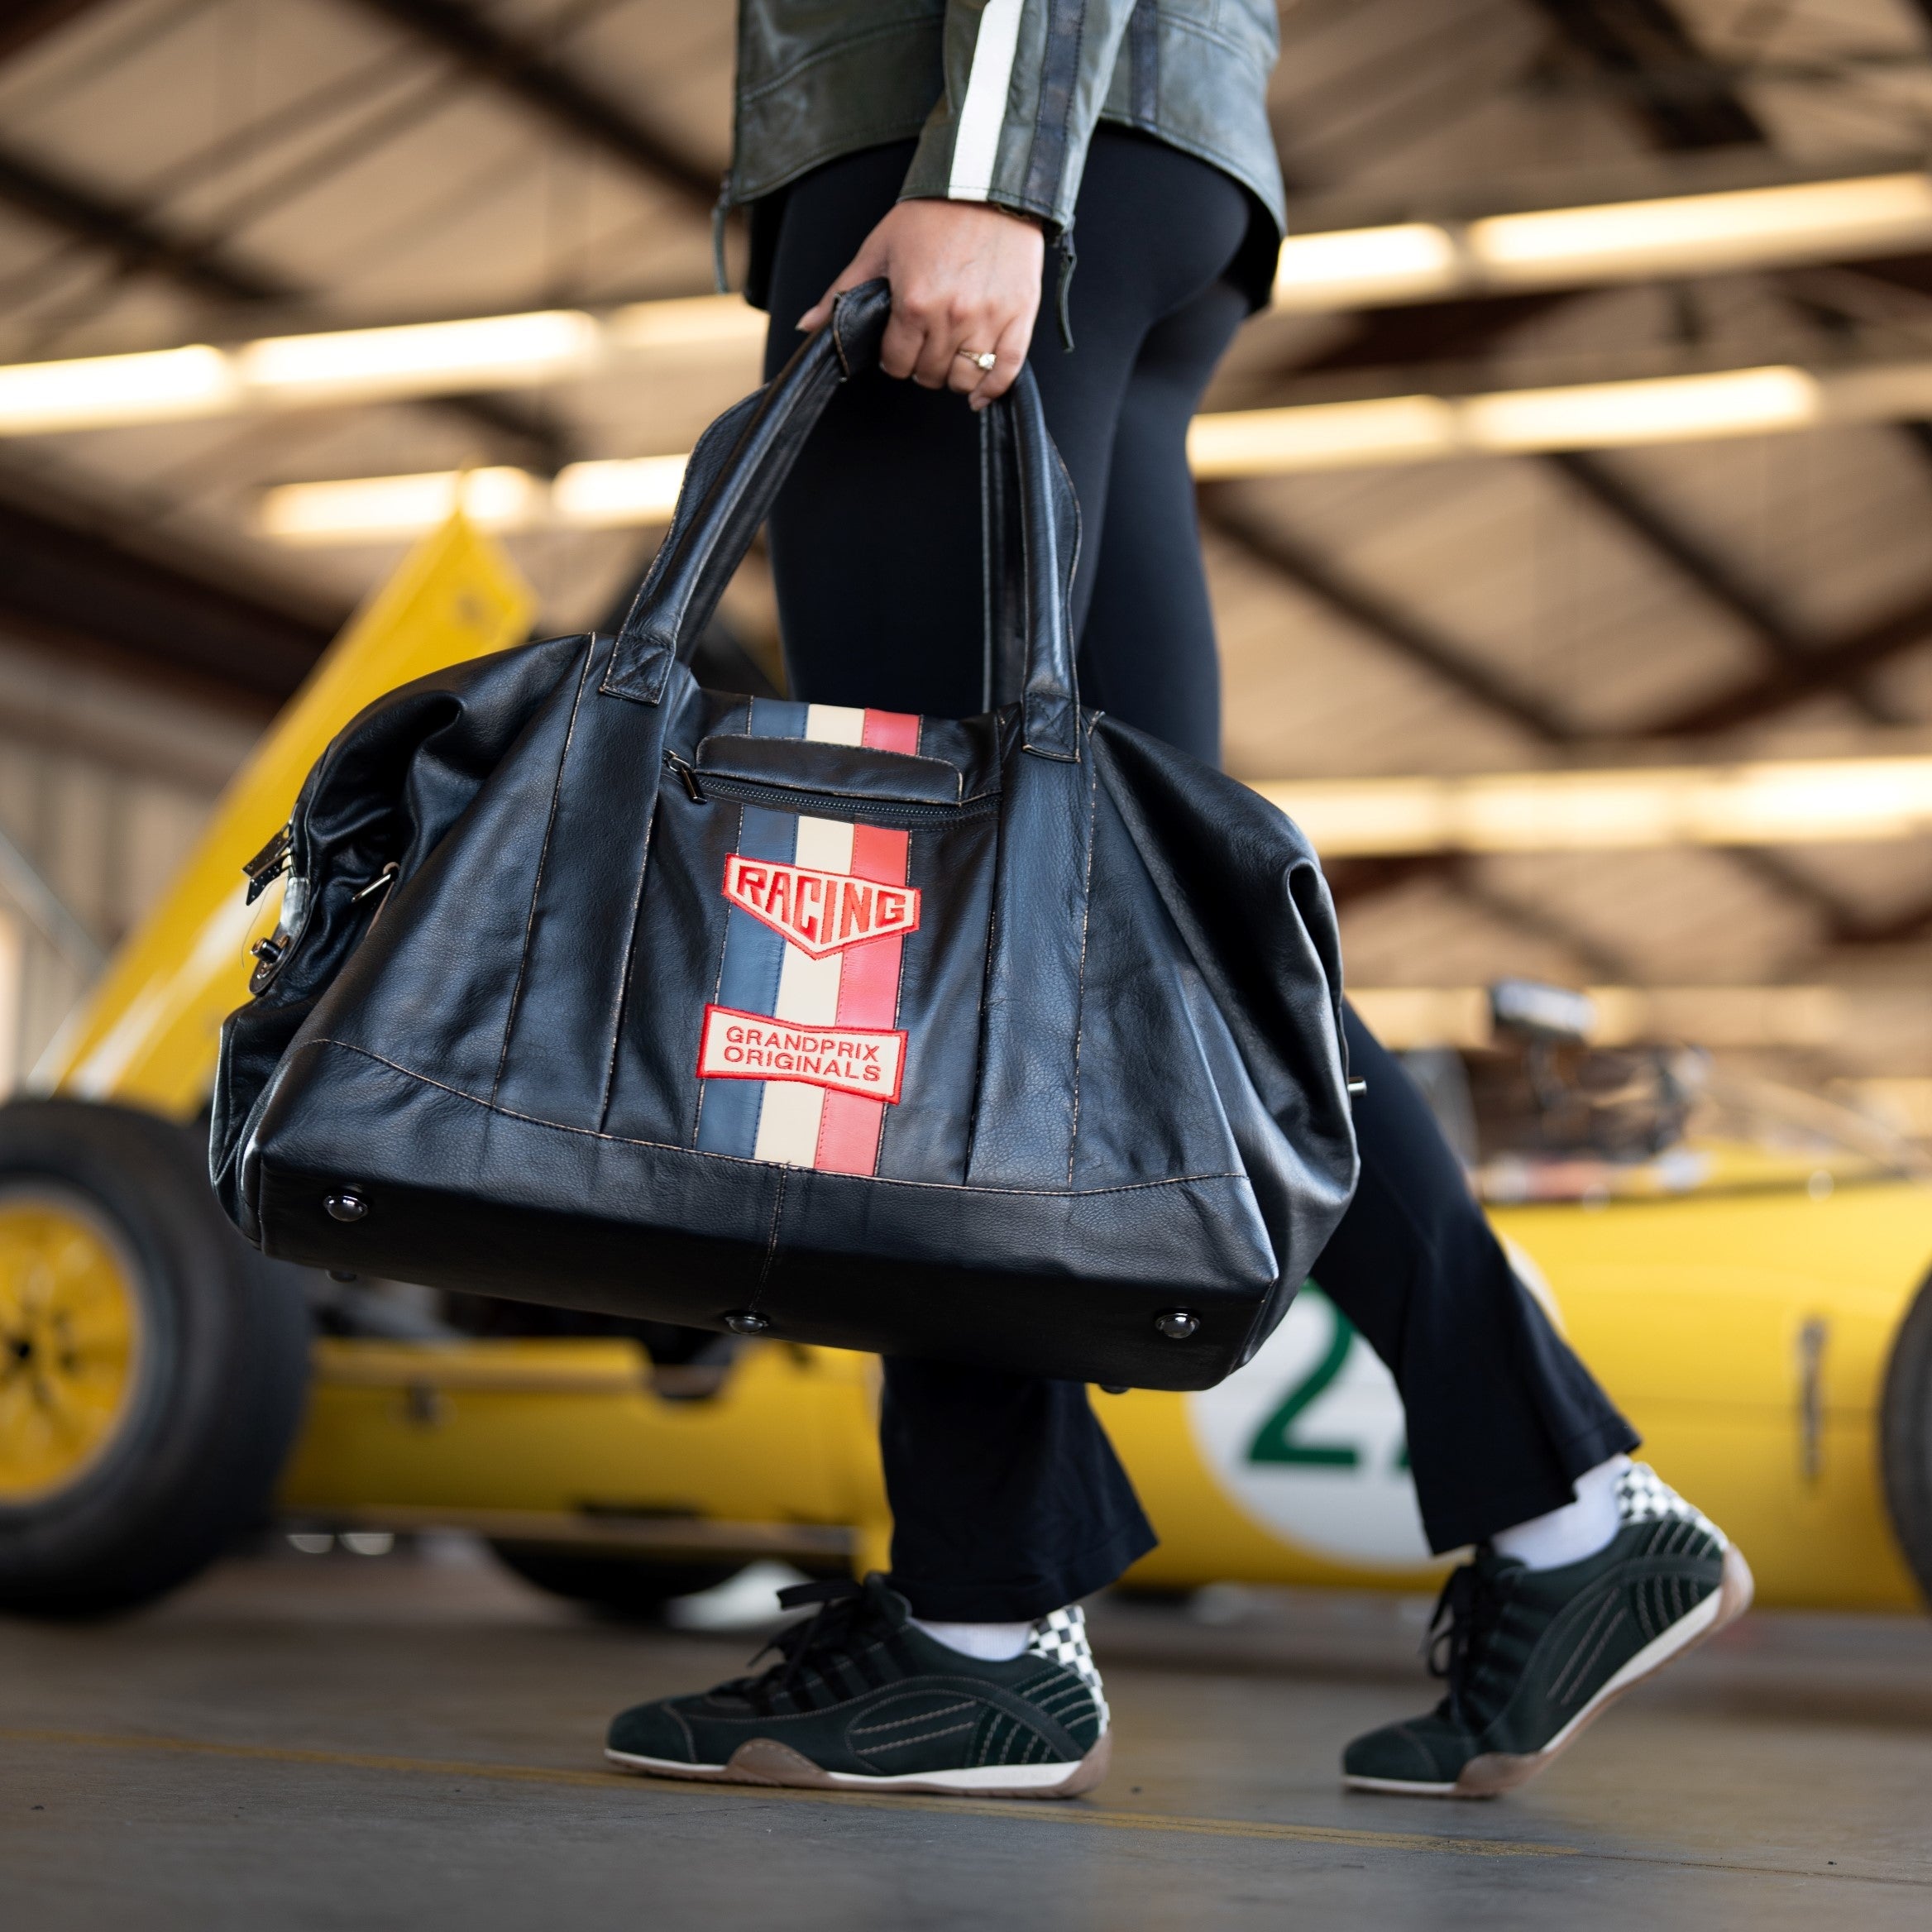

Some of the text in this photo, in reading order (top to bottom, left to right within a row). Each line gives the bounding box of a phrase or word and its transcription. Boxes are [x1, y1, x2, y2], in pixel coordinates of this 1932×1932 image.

[736, 865, 906, 944] RACING
[724, 1046, 882, 1082] ORIGINALS
[726, 1026, 880, 1062] GRANDPRIX
[1247, 1278, 1408, 1467] 2
